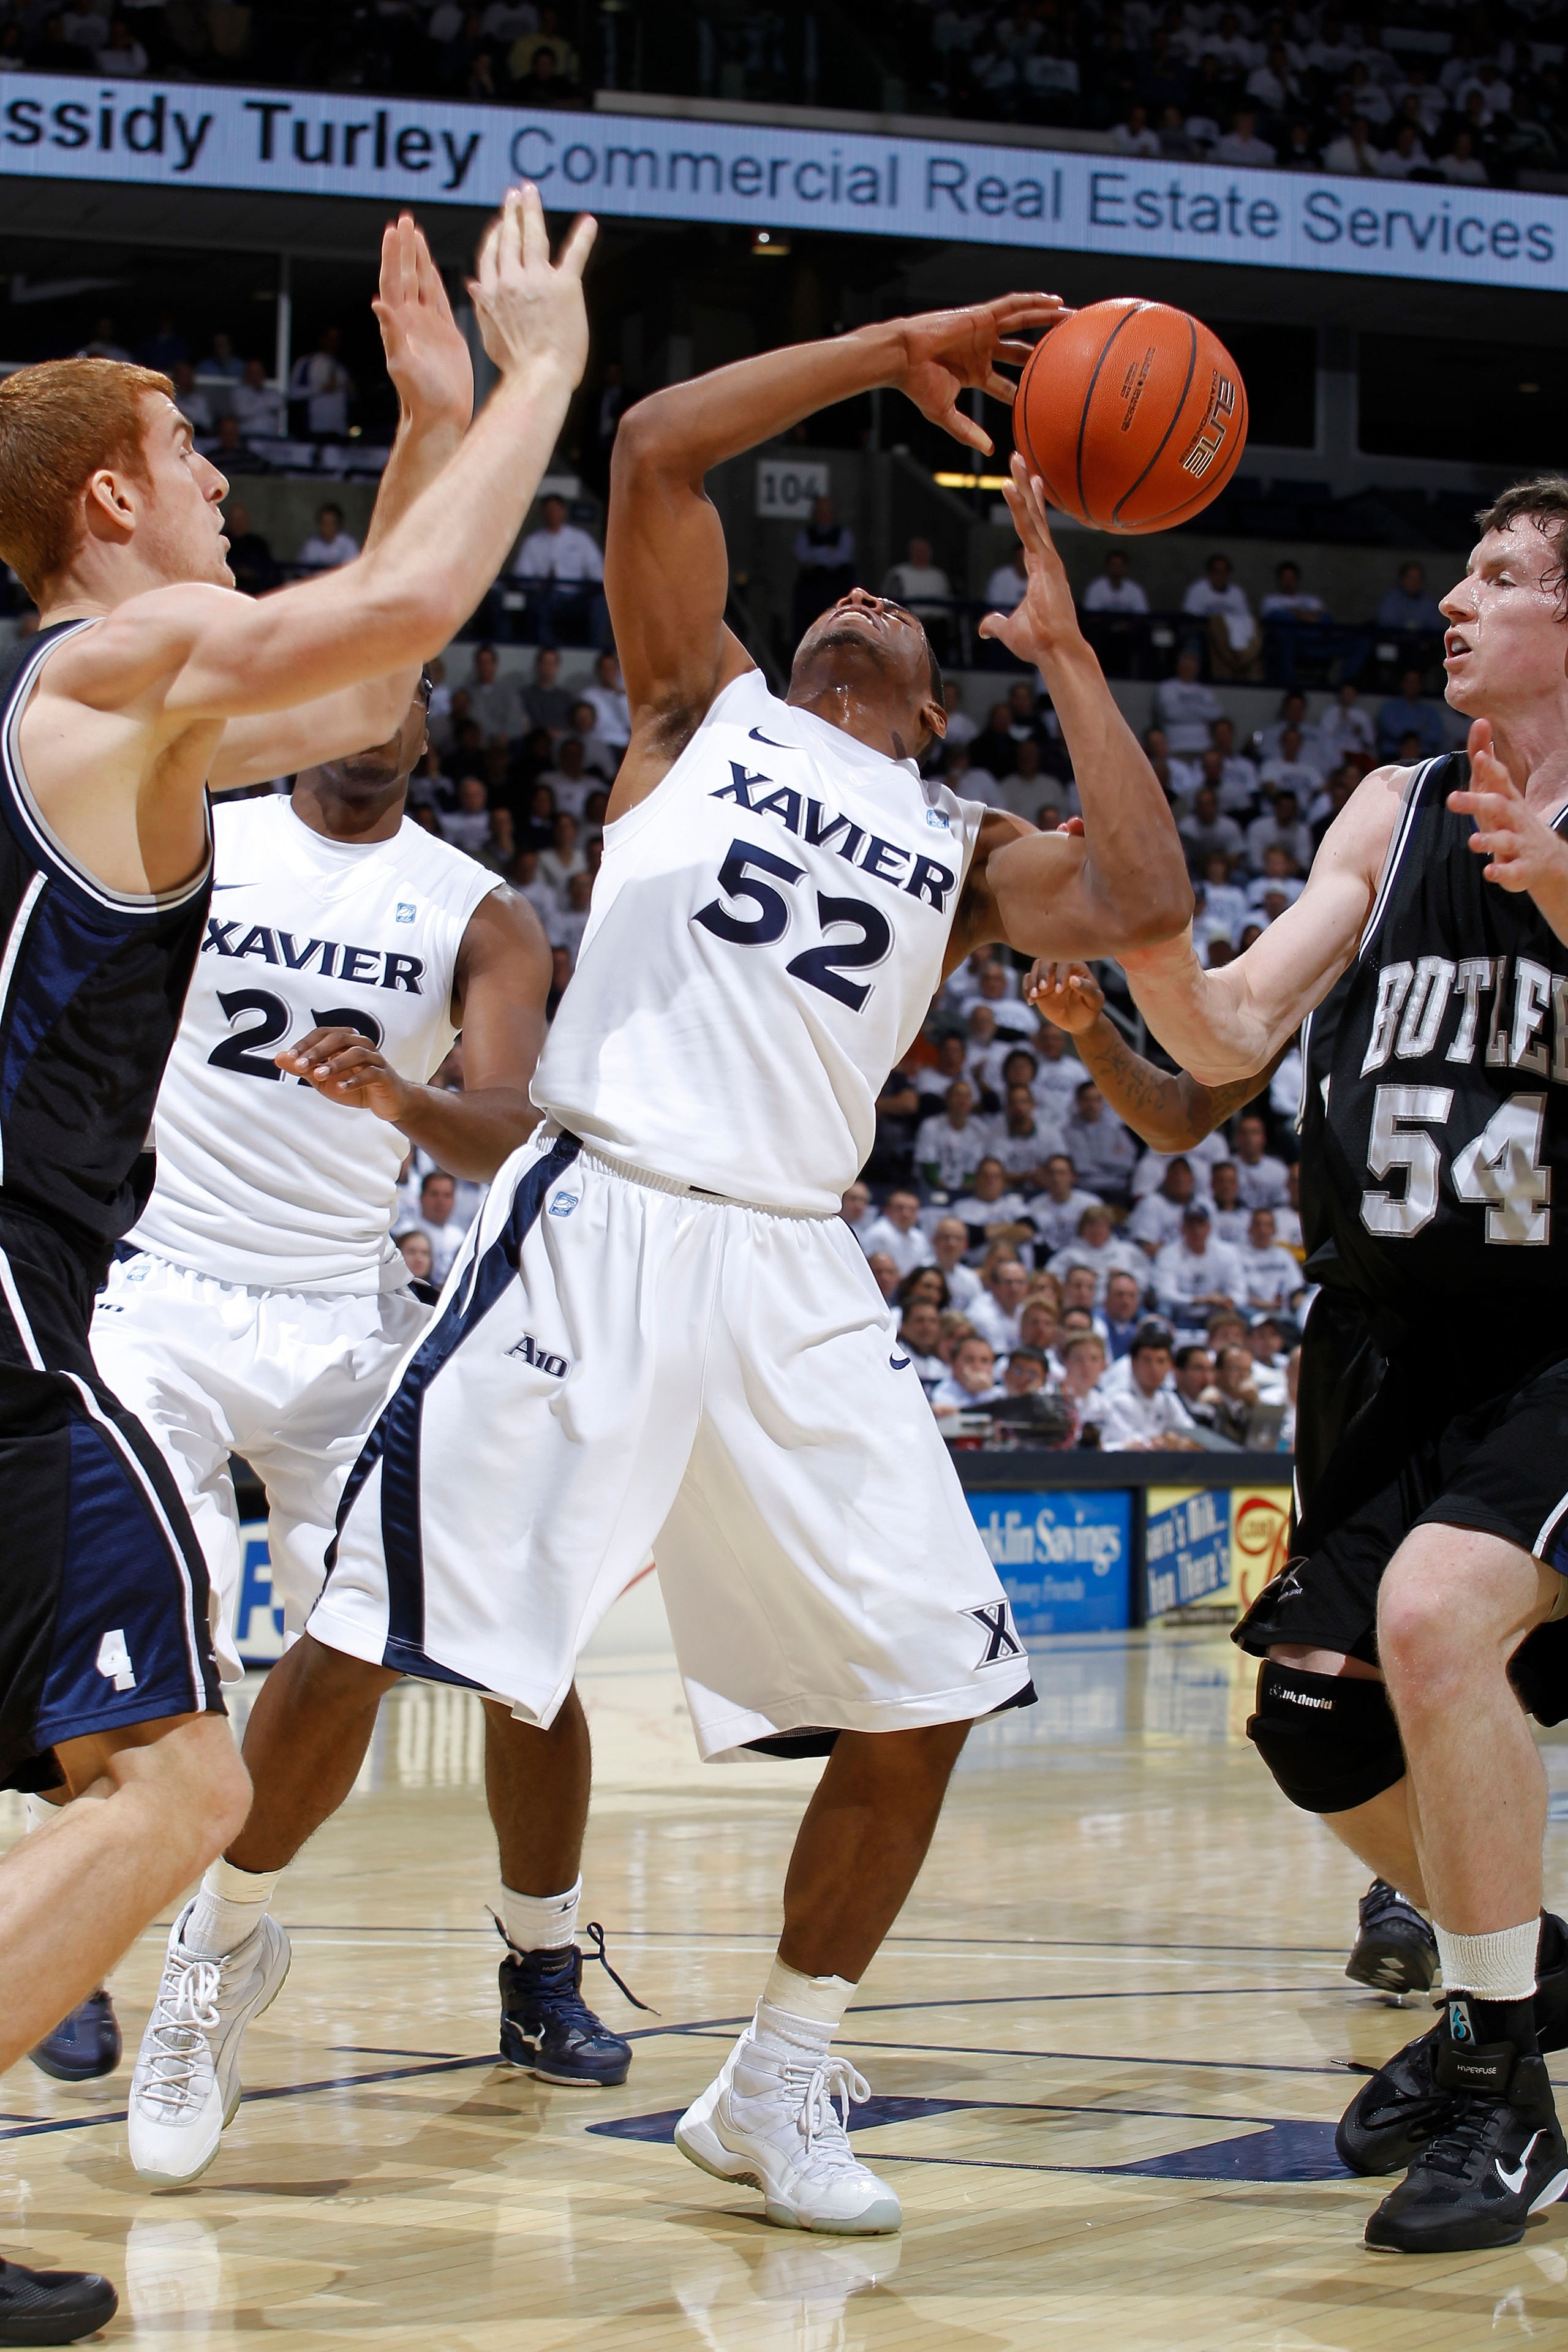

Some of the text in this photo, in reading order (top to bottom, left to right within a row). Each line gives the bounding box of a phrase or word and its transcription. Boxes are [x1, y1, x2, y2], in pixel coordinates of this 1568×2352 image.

[3, 89, 1556, 263] ssidy Turley Commercial Real Estate Services
[1178, 369, 1218, 464] CHAMPIONSHIP
[1183, 374, 1235, 479] ELITE
[765, 472, 819, 507] 104
[708, 760, 958, 915] XAVIER
[202, 918, 427, 995] XAVIER
[687, 838, 896, 1015] 52
[1359, 1084, 1553, 1246] 54
[1036, 1507, 1121, 1577] Savings
[96, 1628, 137, 1692] 4
[1457, 2064, 1497, 2075] HYPERFUSE
